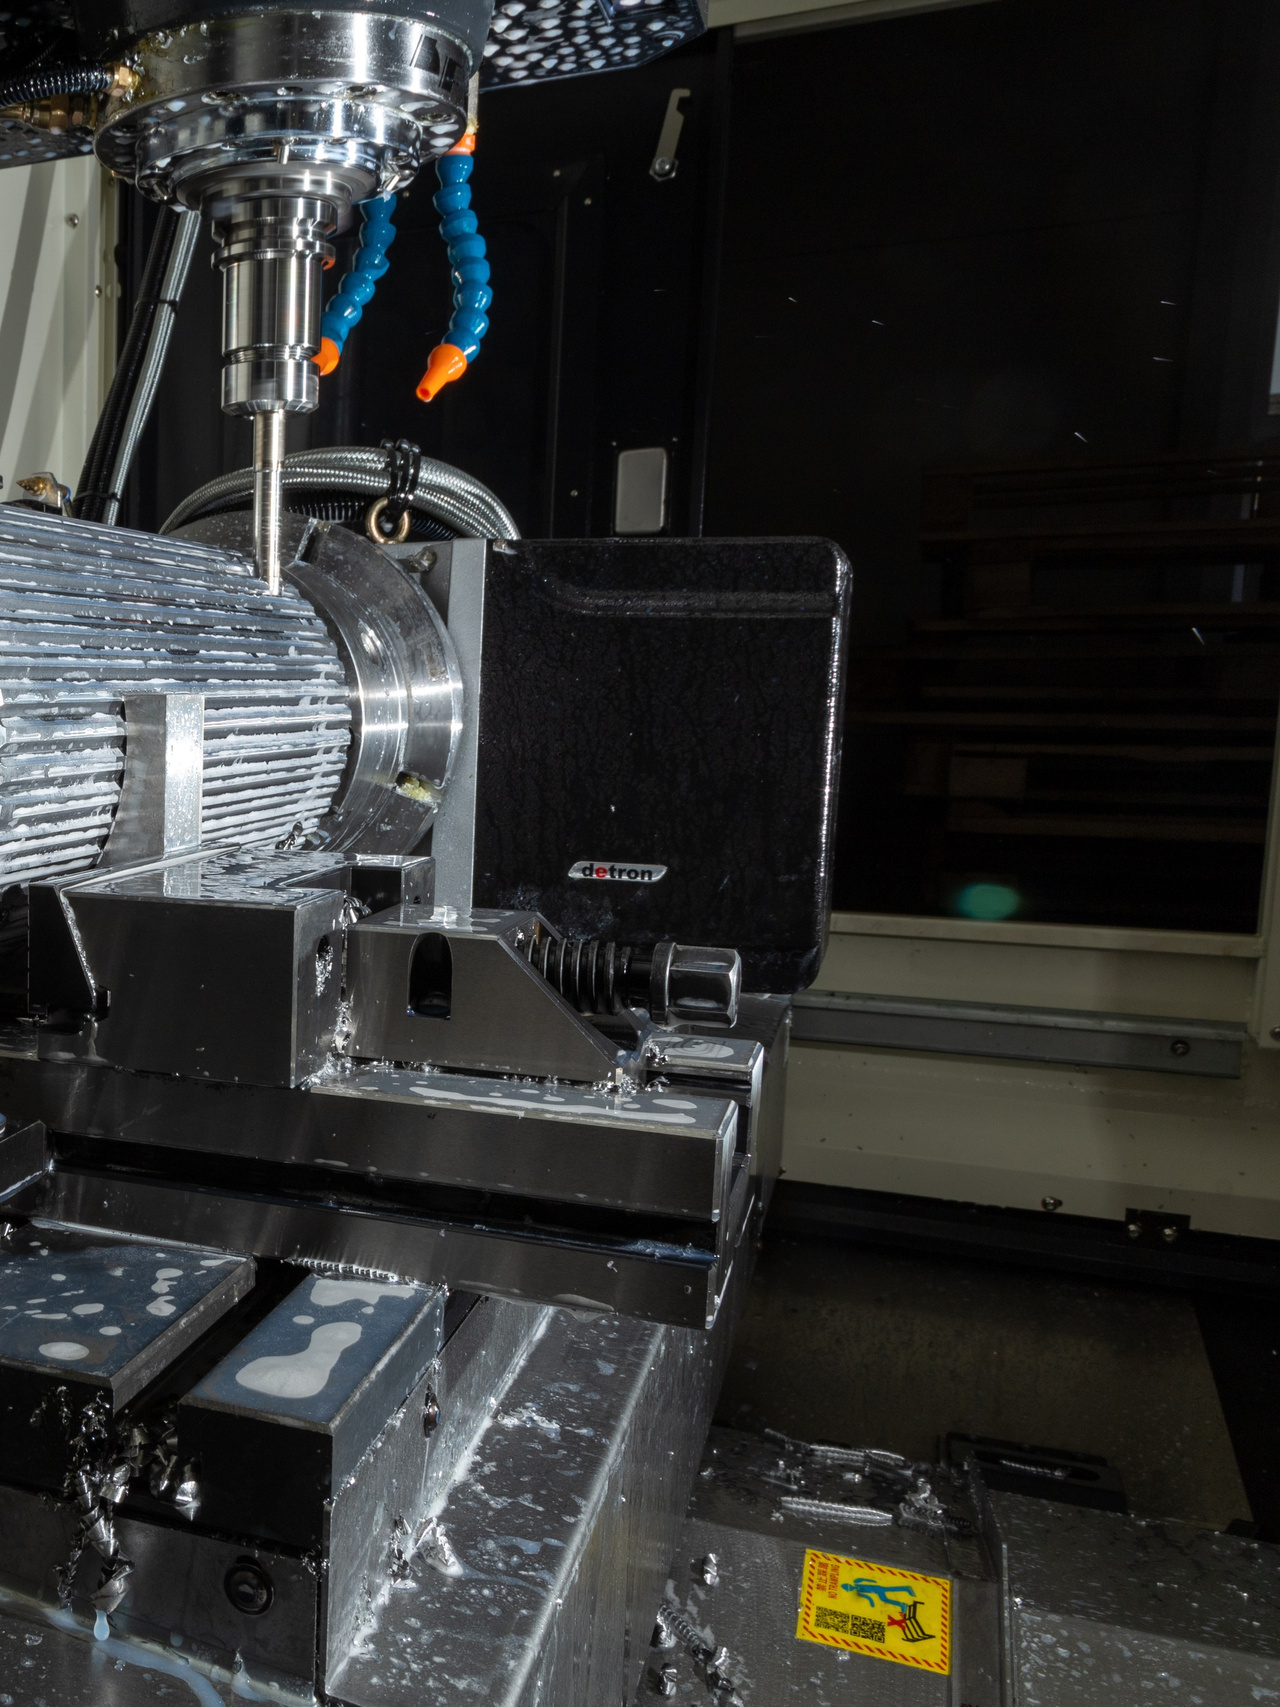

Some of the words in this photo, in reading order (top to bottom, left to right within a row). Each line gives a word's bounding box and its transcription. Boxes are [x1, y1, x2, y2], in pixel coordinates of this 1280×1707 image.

[581, 863, 653, 880] detron
[828, 1564, 840, 1591] TRAMPLING
[828, 1591, 838, 1599] NO
